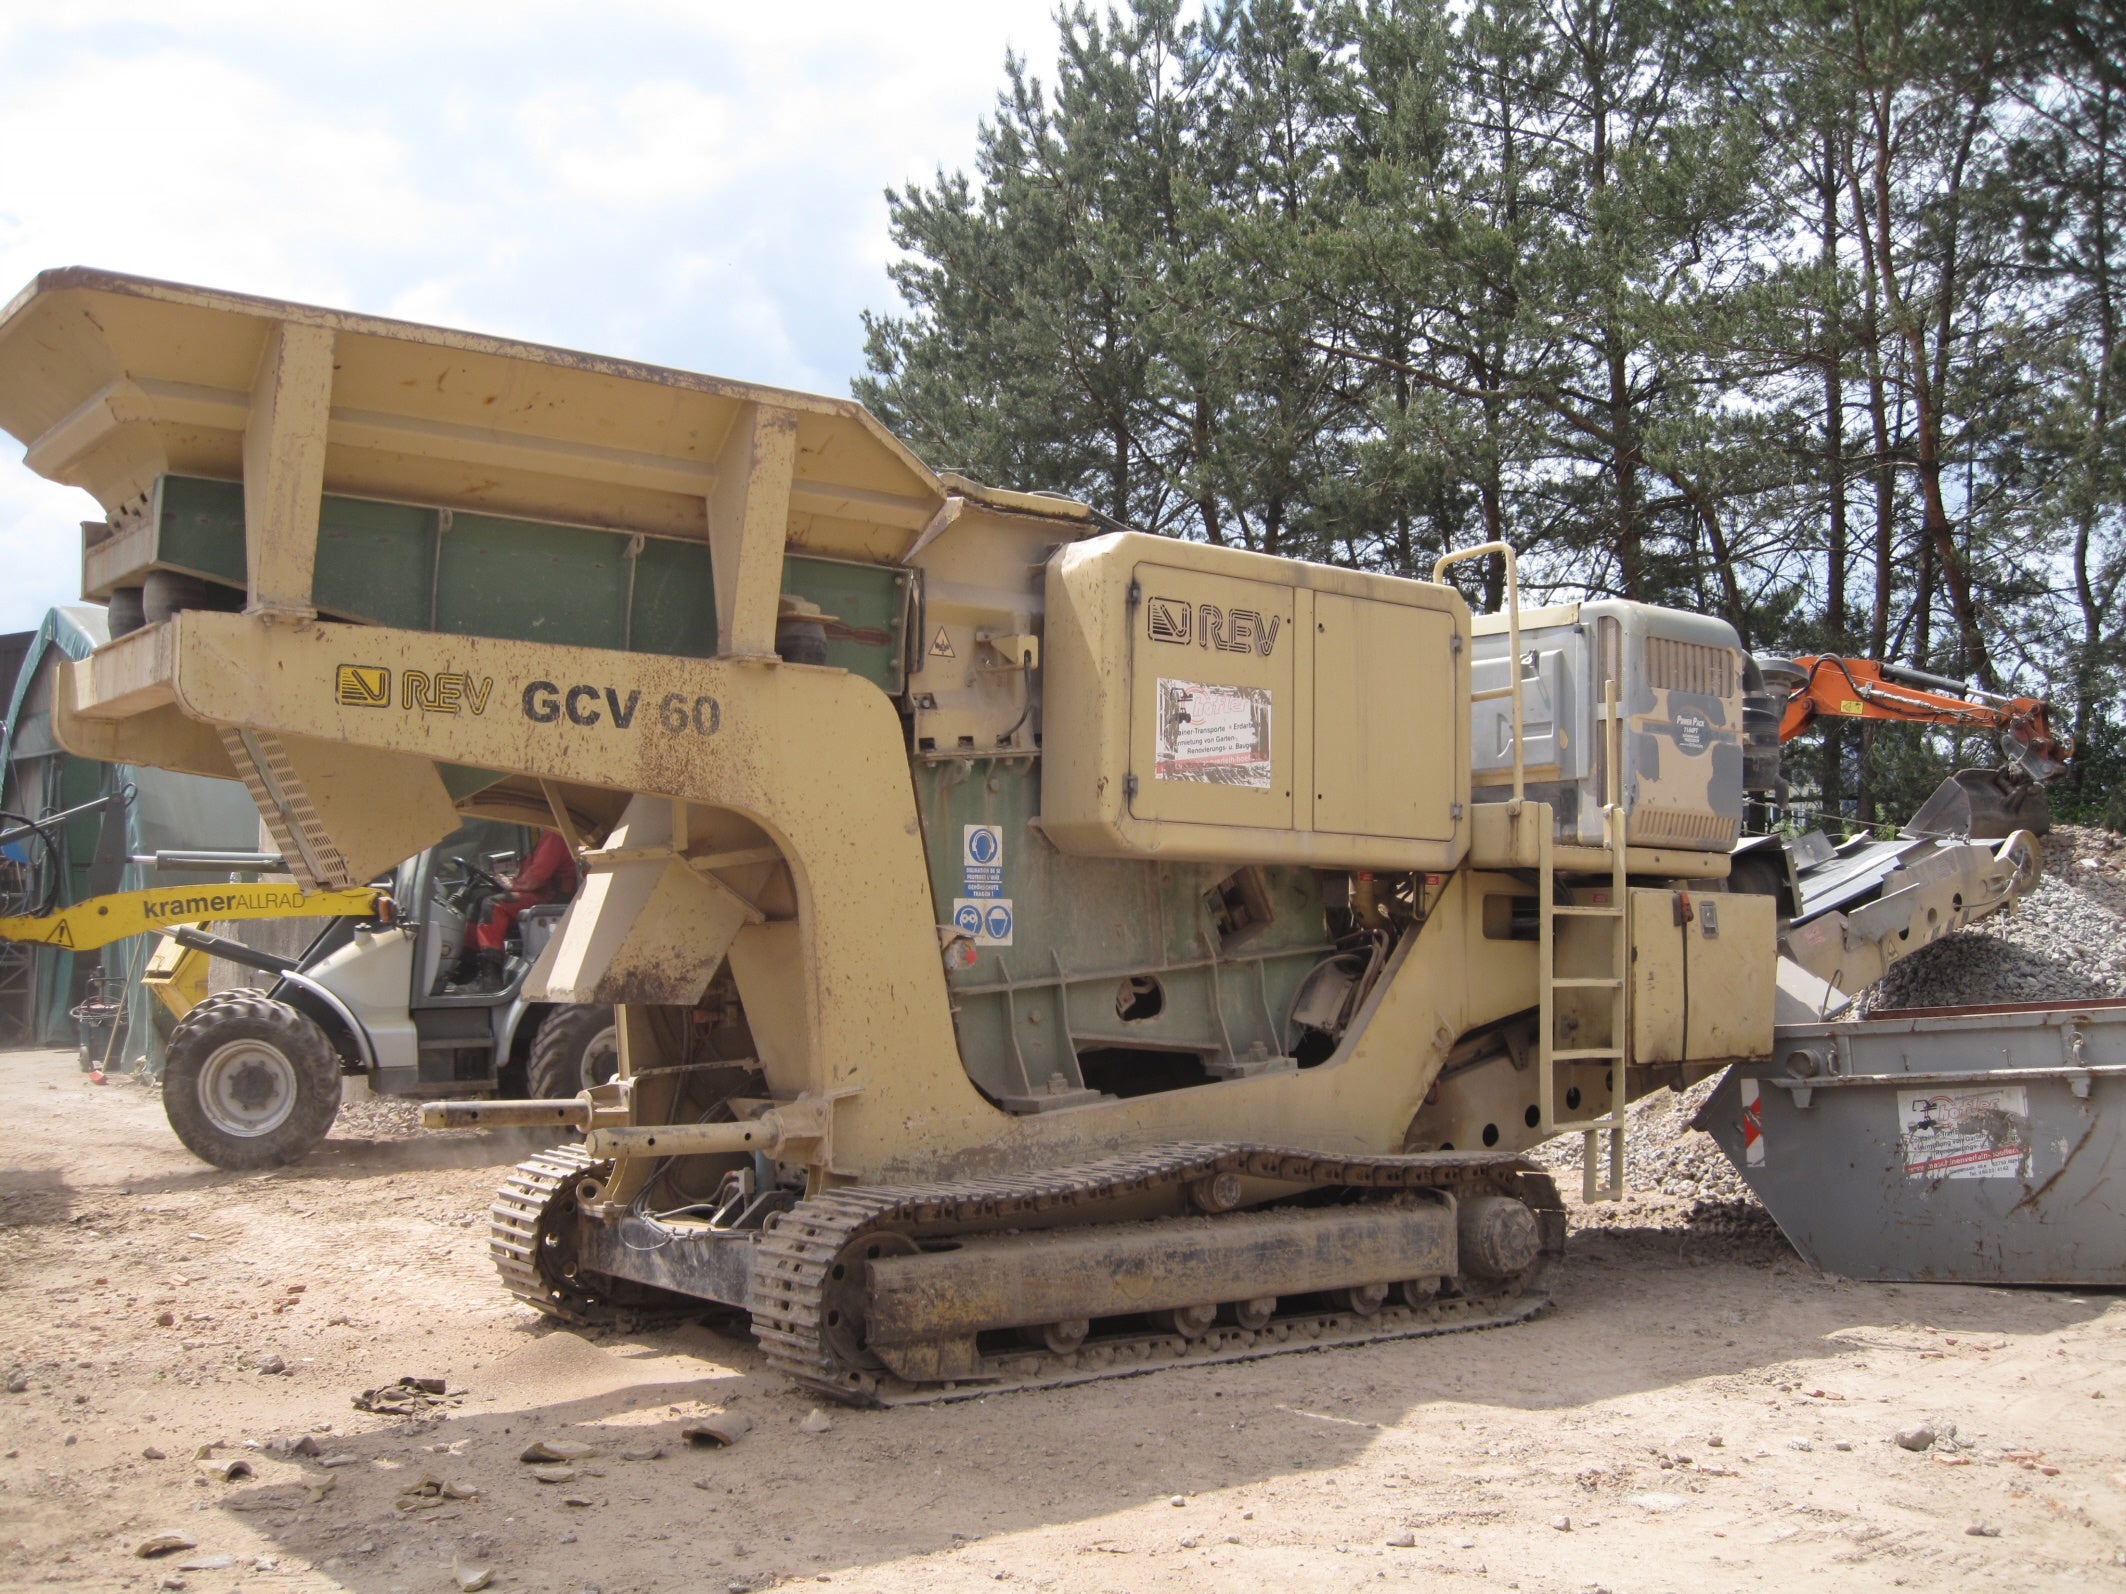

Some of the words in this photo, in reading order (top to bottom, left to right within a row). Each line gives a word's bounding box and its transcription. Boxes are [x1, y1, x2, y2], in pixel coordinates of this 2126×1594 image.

[1199, 604, 1281, 657] REV
[402, 669, 494, 716] REV
[521, 680, 642, 730] GCV
[659, 691, 721, 737] 60
